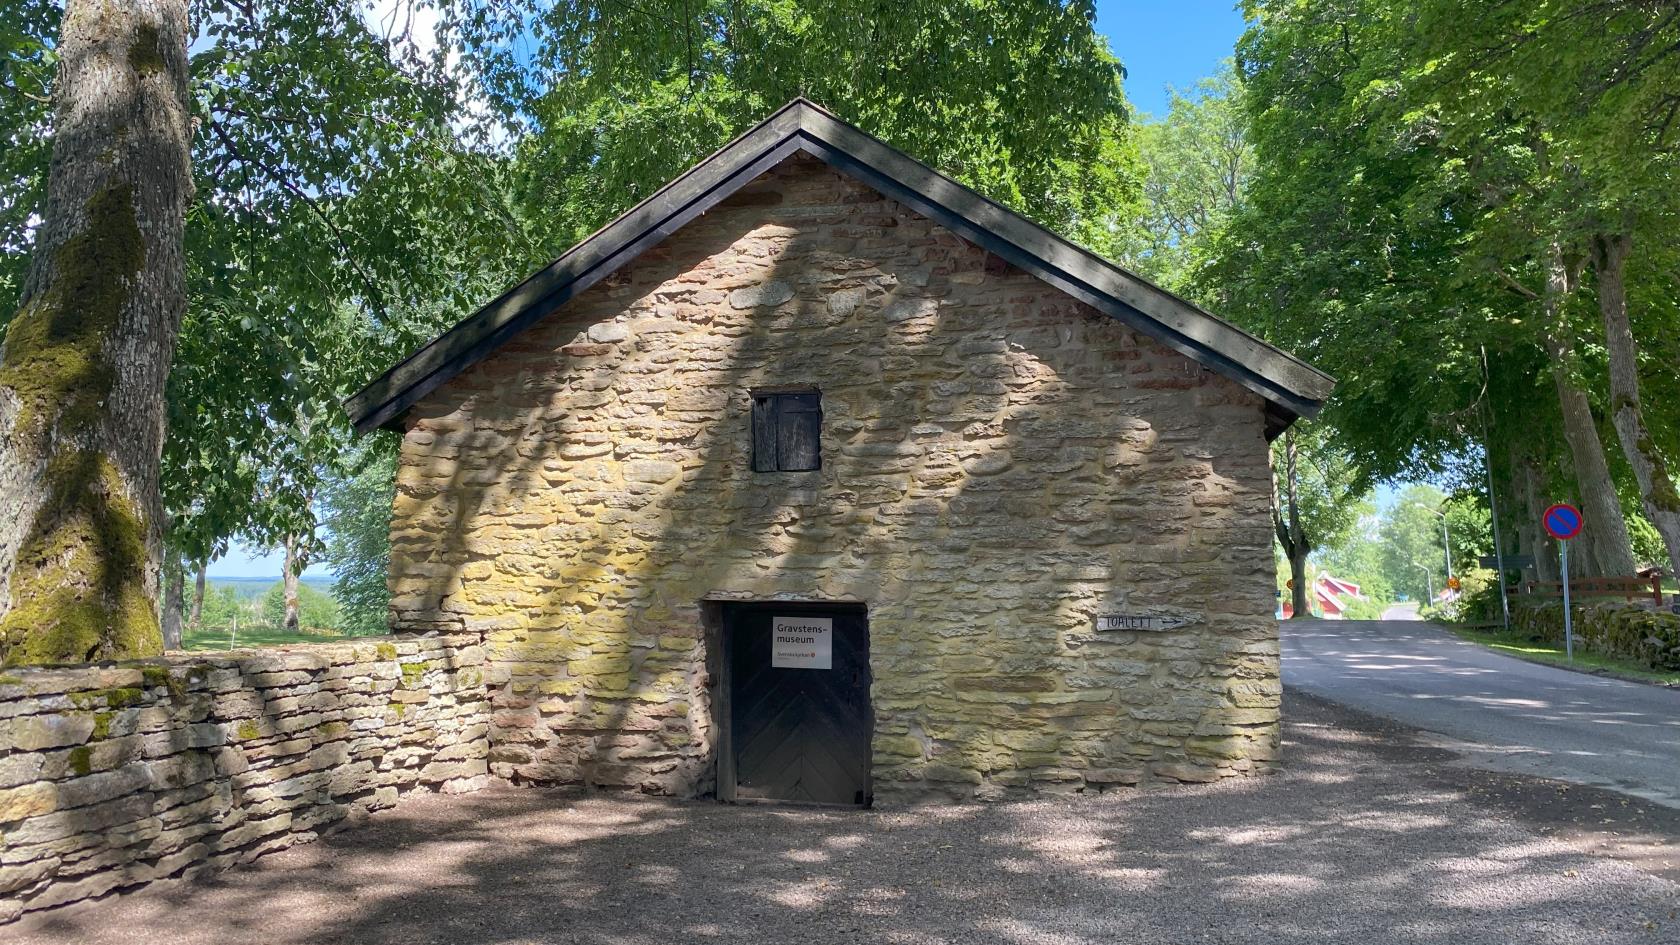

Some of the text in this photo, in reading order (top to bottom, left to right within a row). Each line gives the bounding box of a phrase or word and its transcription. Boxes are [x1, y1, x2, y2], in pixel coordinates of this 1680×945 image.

[1106, 616, 1152, 628] TOALETT
[777, 623, 828, 633] Gravstens-
[776, 636, 814, 644] museum
